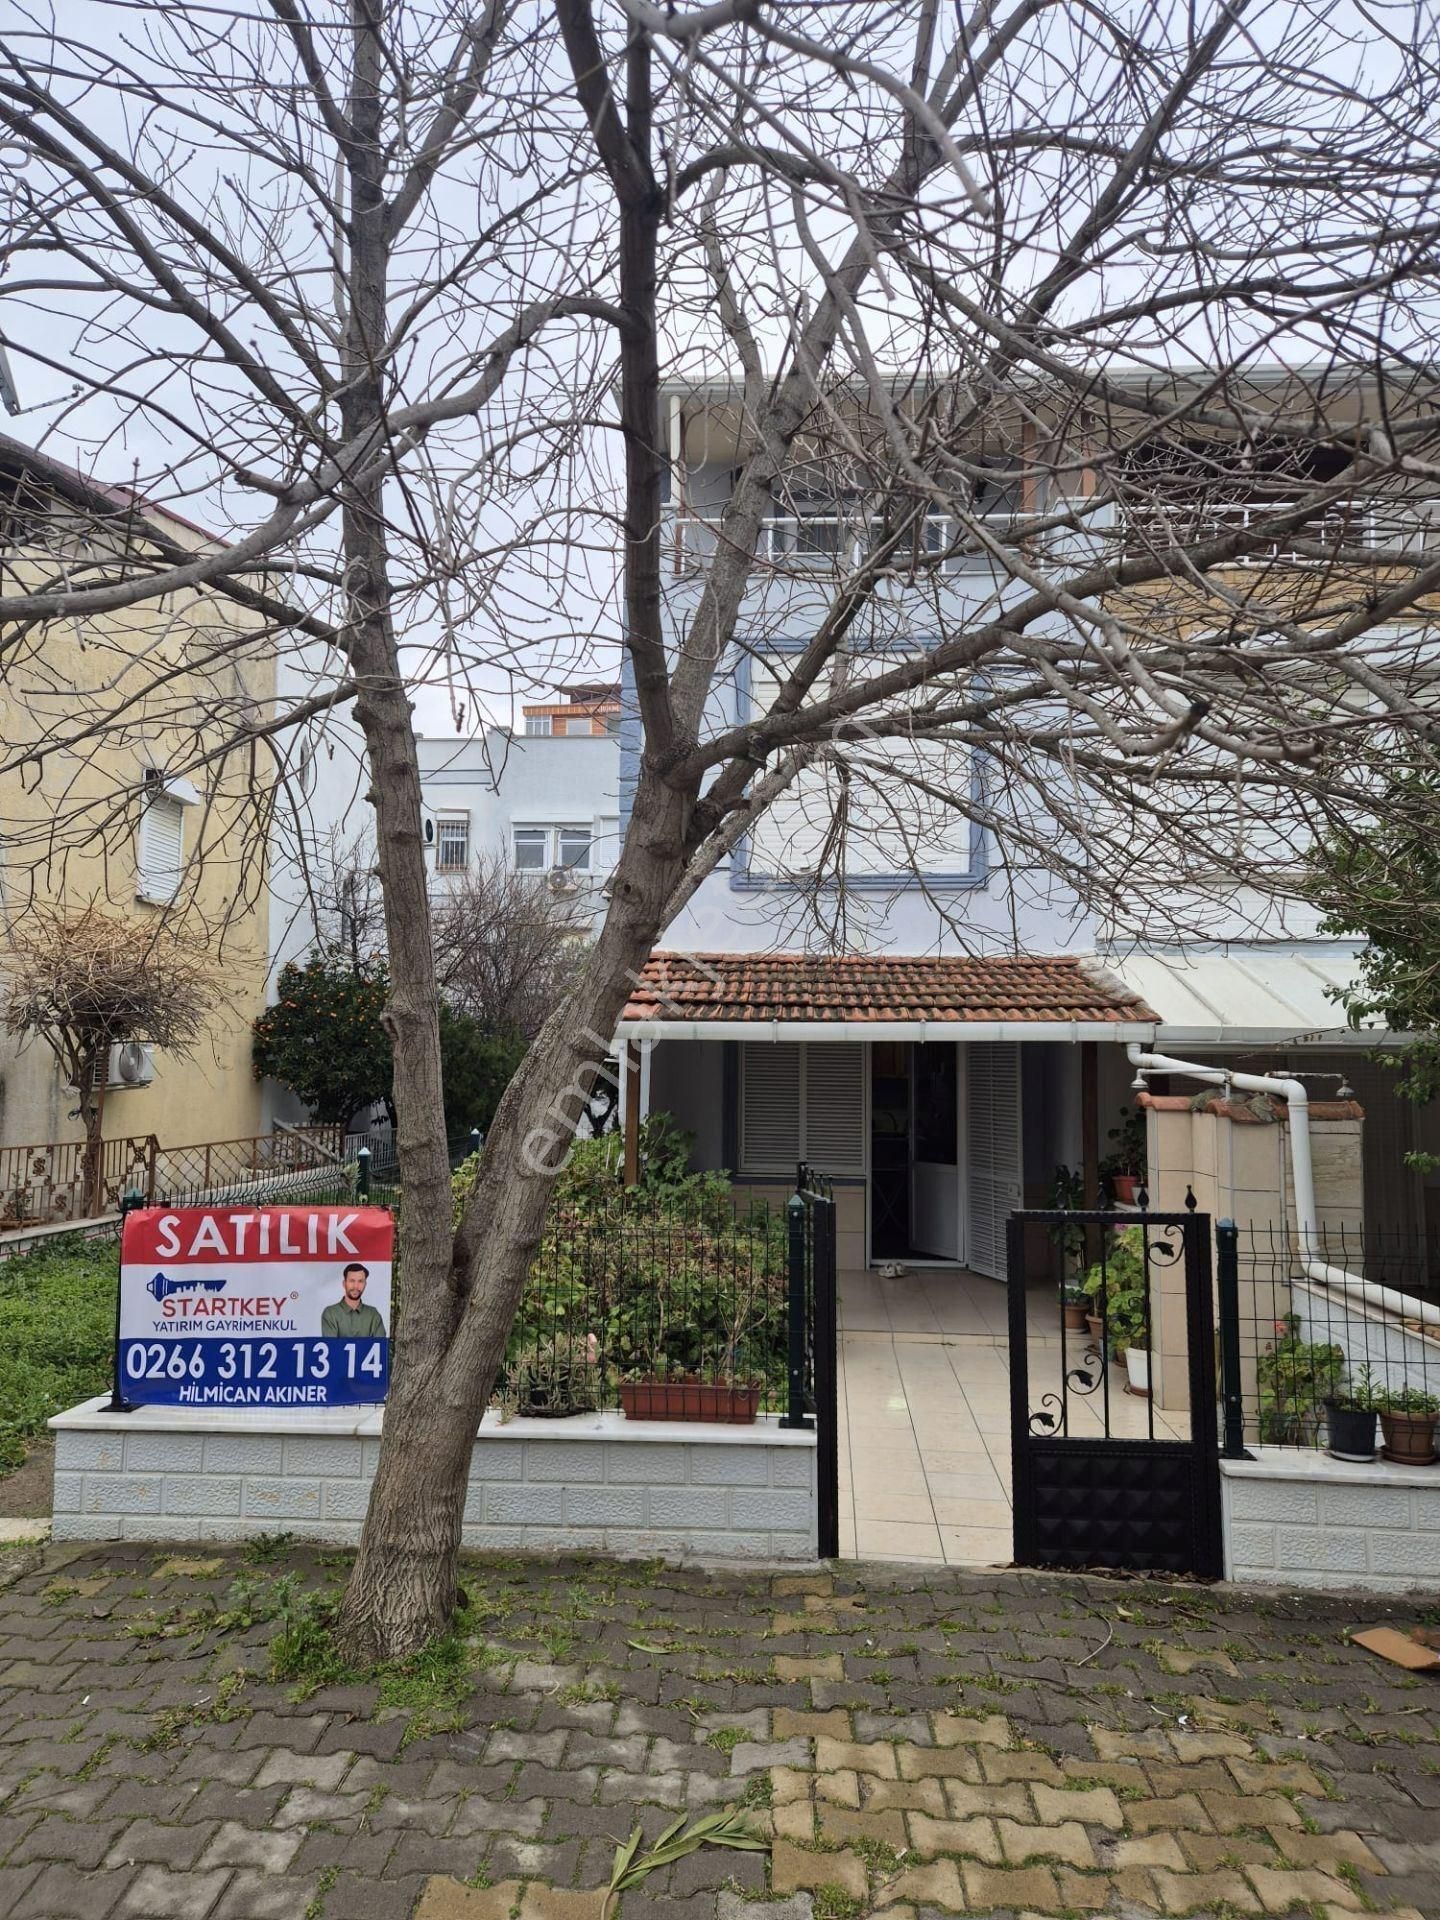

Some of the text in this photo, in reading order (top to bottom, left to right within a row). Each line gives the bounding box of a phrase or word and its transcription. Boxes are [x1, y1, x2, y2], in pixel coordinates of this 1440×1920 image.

[155, 1214, 360, 1257] SATILIK
[153, 1318, 297, 1332] YATIRIM GAYRİMENKUL
[127, 1343, 382, 1379] 0266 312 13 14
[179, 1381, 327, 1403] HİLMİCAN AKINER
